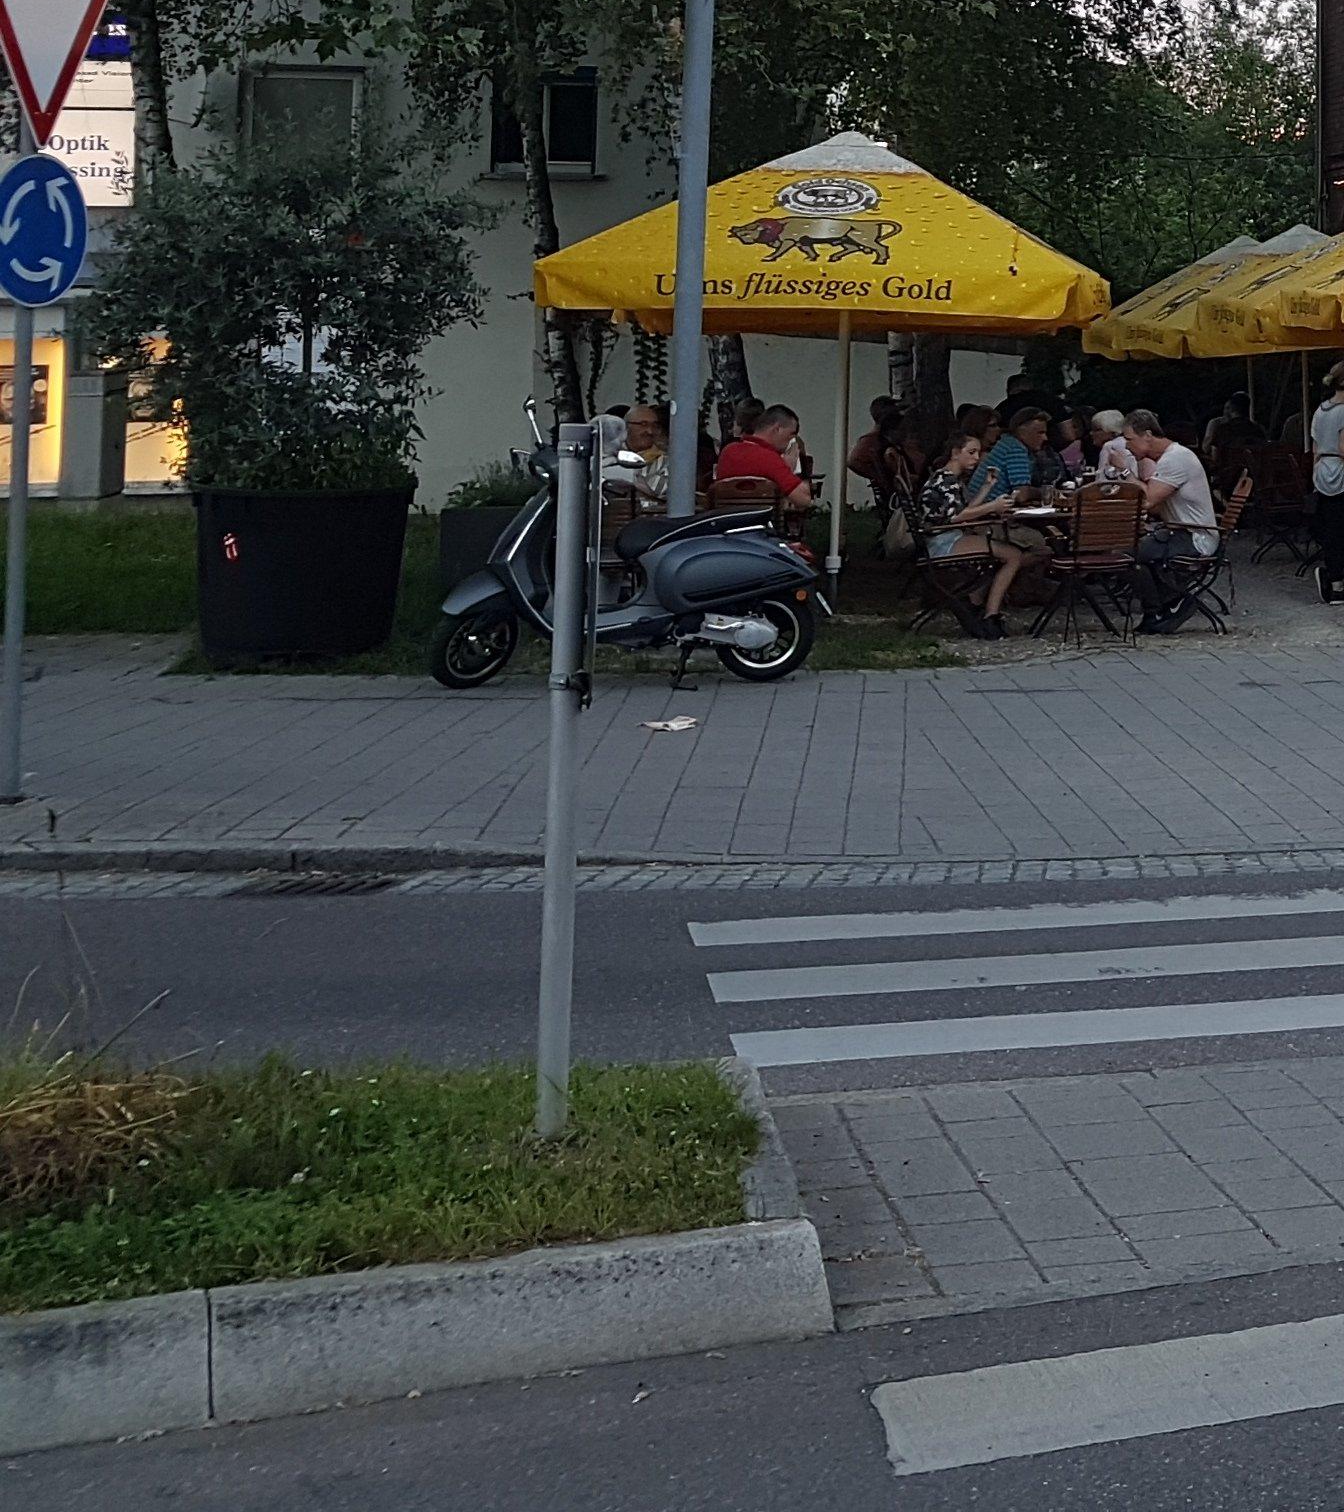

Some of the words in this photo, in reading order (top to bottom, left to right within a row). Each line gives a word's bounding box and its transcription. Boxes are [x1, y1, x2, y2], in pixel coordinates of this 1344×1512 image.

[50, 134, 110, 155] Optik
[654, 273, 733, 296] Ums
[736, 272, 872, 301] flüssiges
[882, 276, 953, 301] Gold
